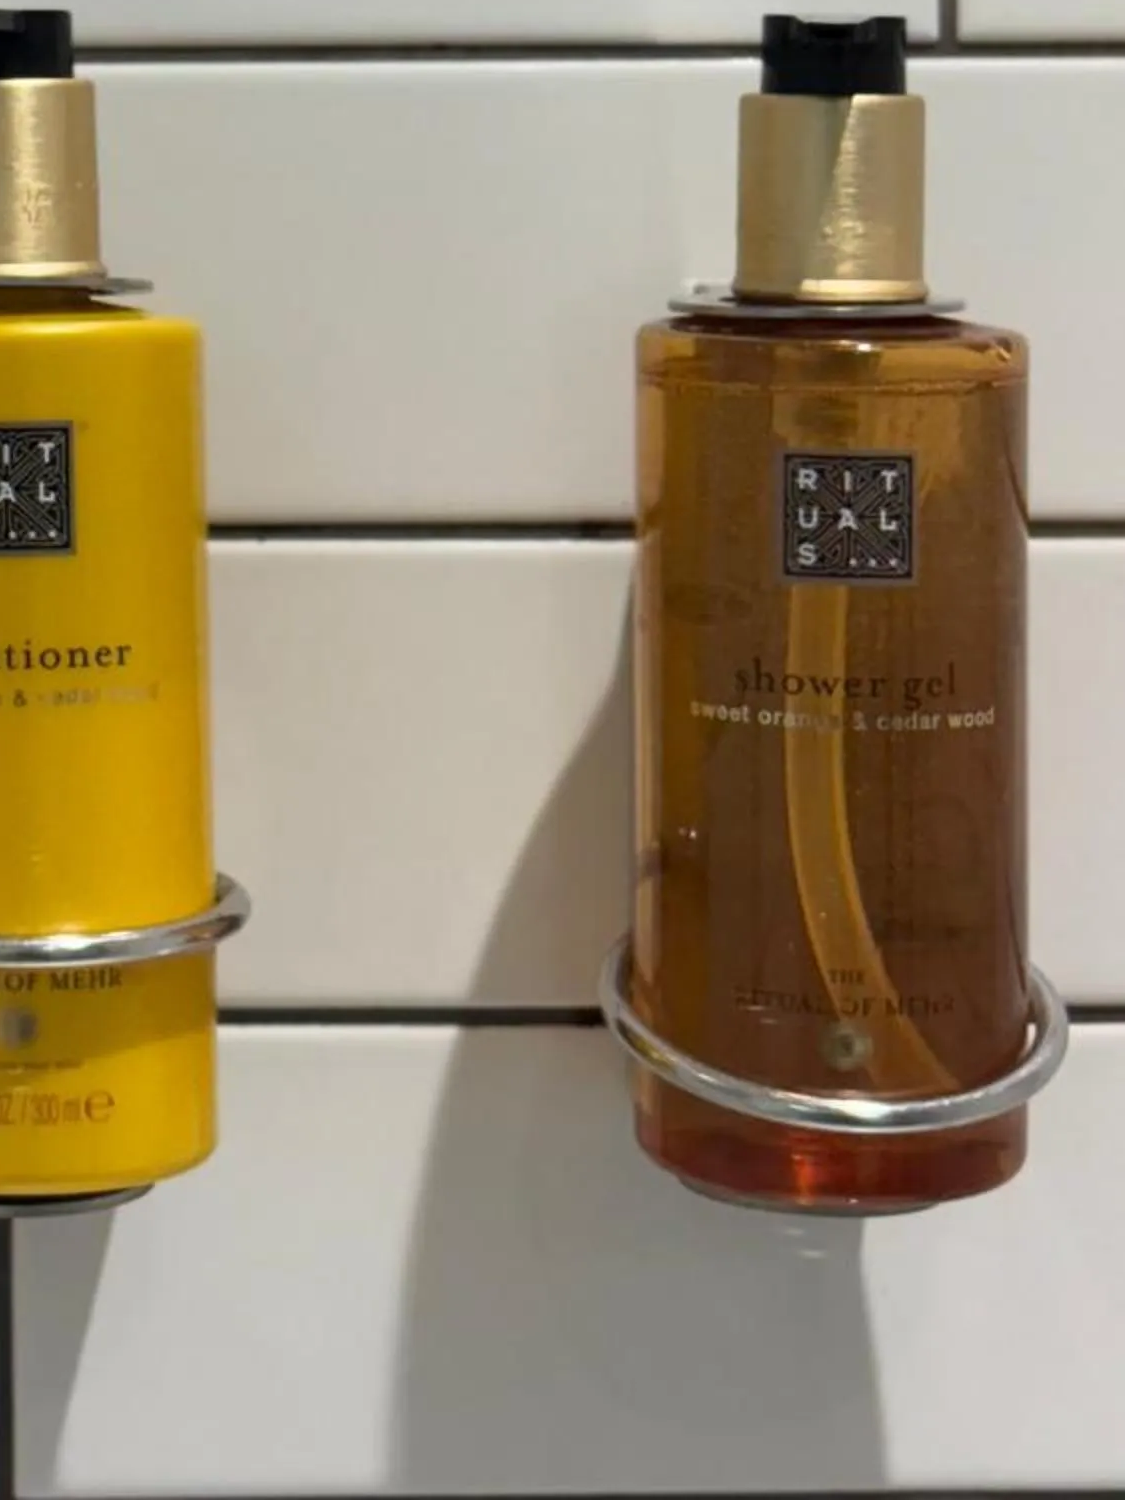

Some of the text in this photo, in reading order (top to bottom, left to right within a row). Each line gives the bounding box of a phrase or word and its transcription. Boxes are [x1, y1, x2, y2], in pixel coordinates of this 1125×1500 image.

[734, 657, 956, 711] shower gel
[690, 700, 751, 724] sweet
[876, 711, 941, 732] cedar
[947, 707, 996, 728] wood
[4, 970, 39, 993] OF
[50, 965, 124, 990] MEHR
